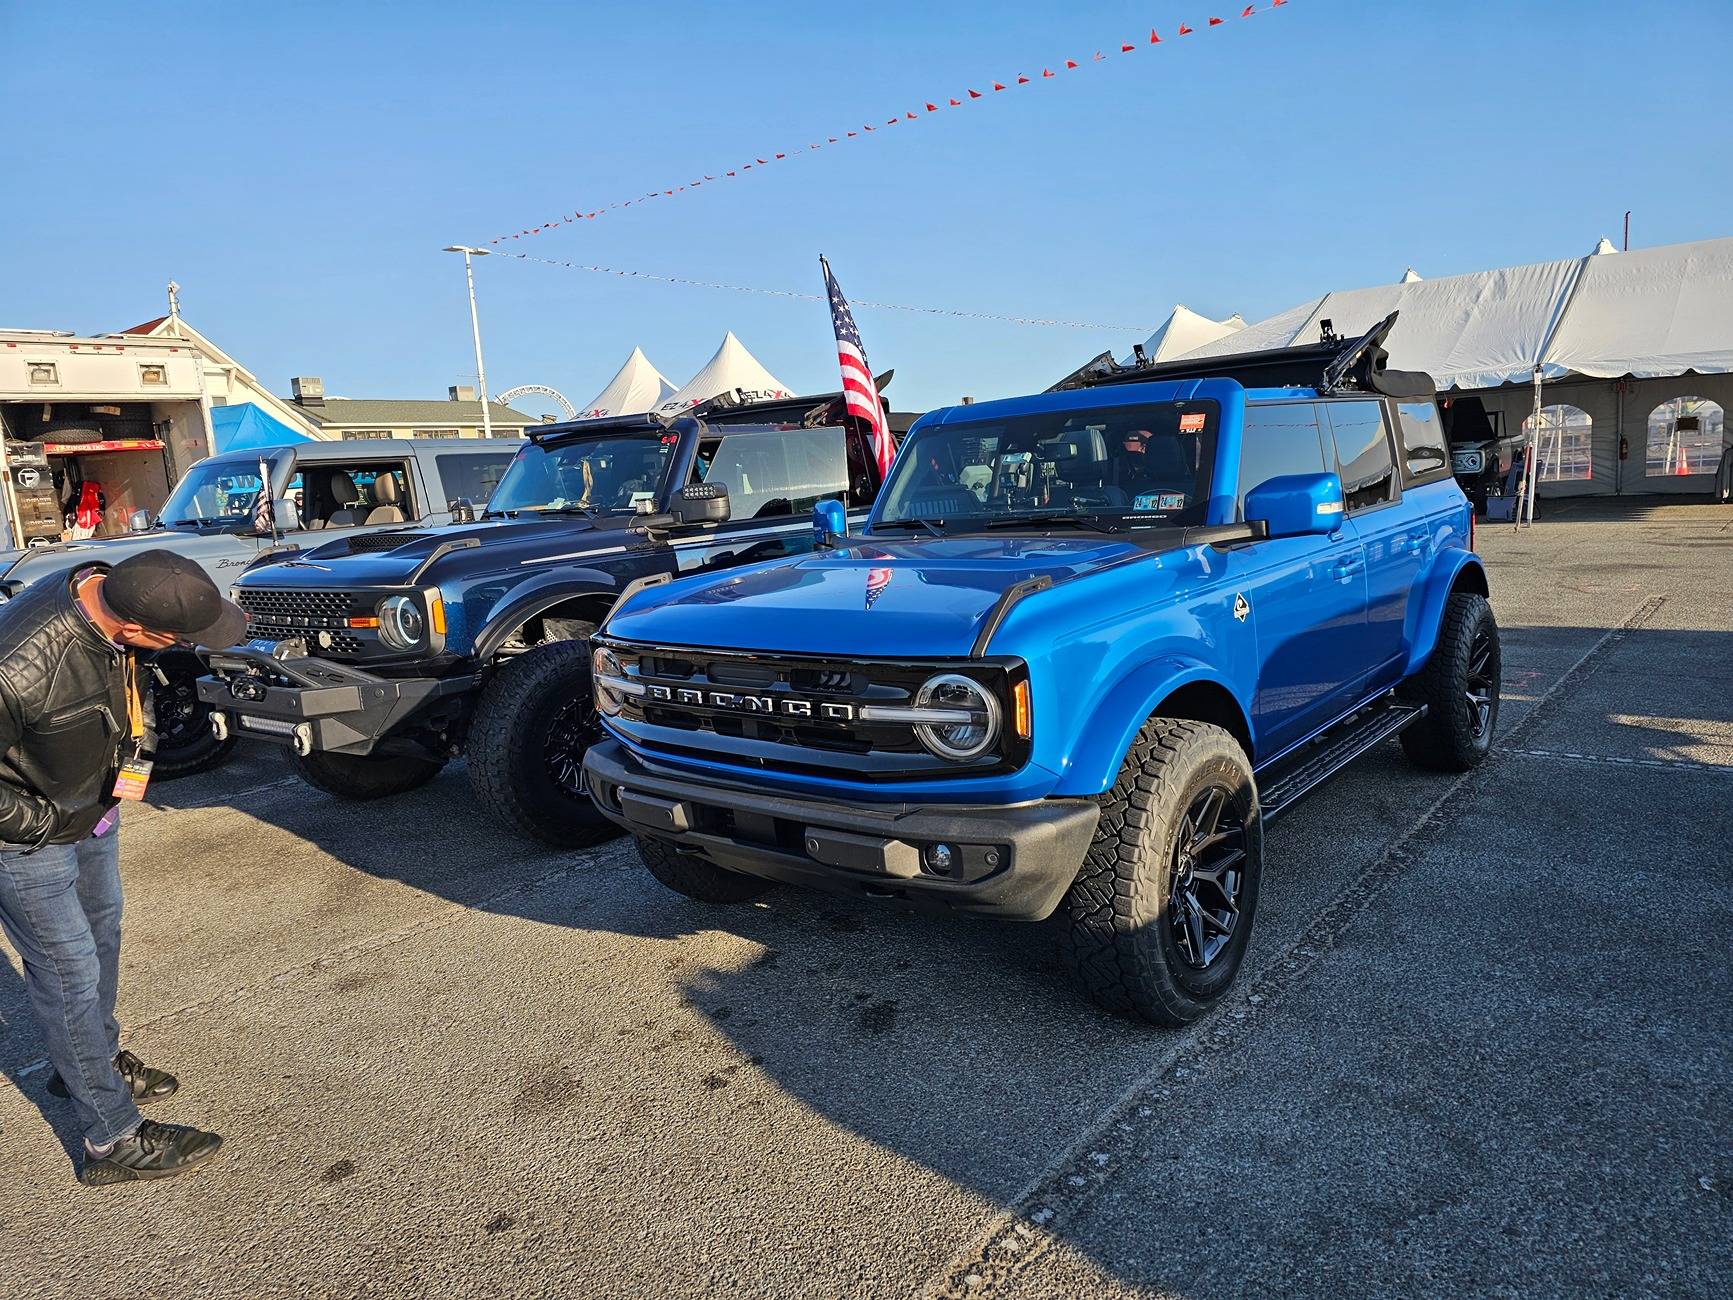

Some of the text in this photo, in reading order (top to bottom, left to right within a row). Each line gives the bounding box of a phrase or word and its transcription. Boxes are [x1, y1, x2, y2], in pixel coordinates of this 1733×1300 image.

[661, 398, 706, 411] EZ4X
[216, 558, 251, 569] Bronc
[648, 685, 853, 720] BRONCO
